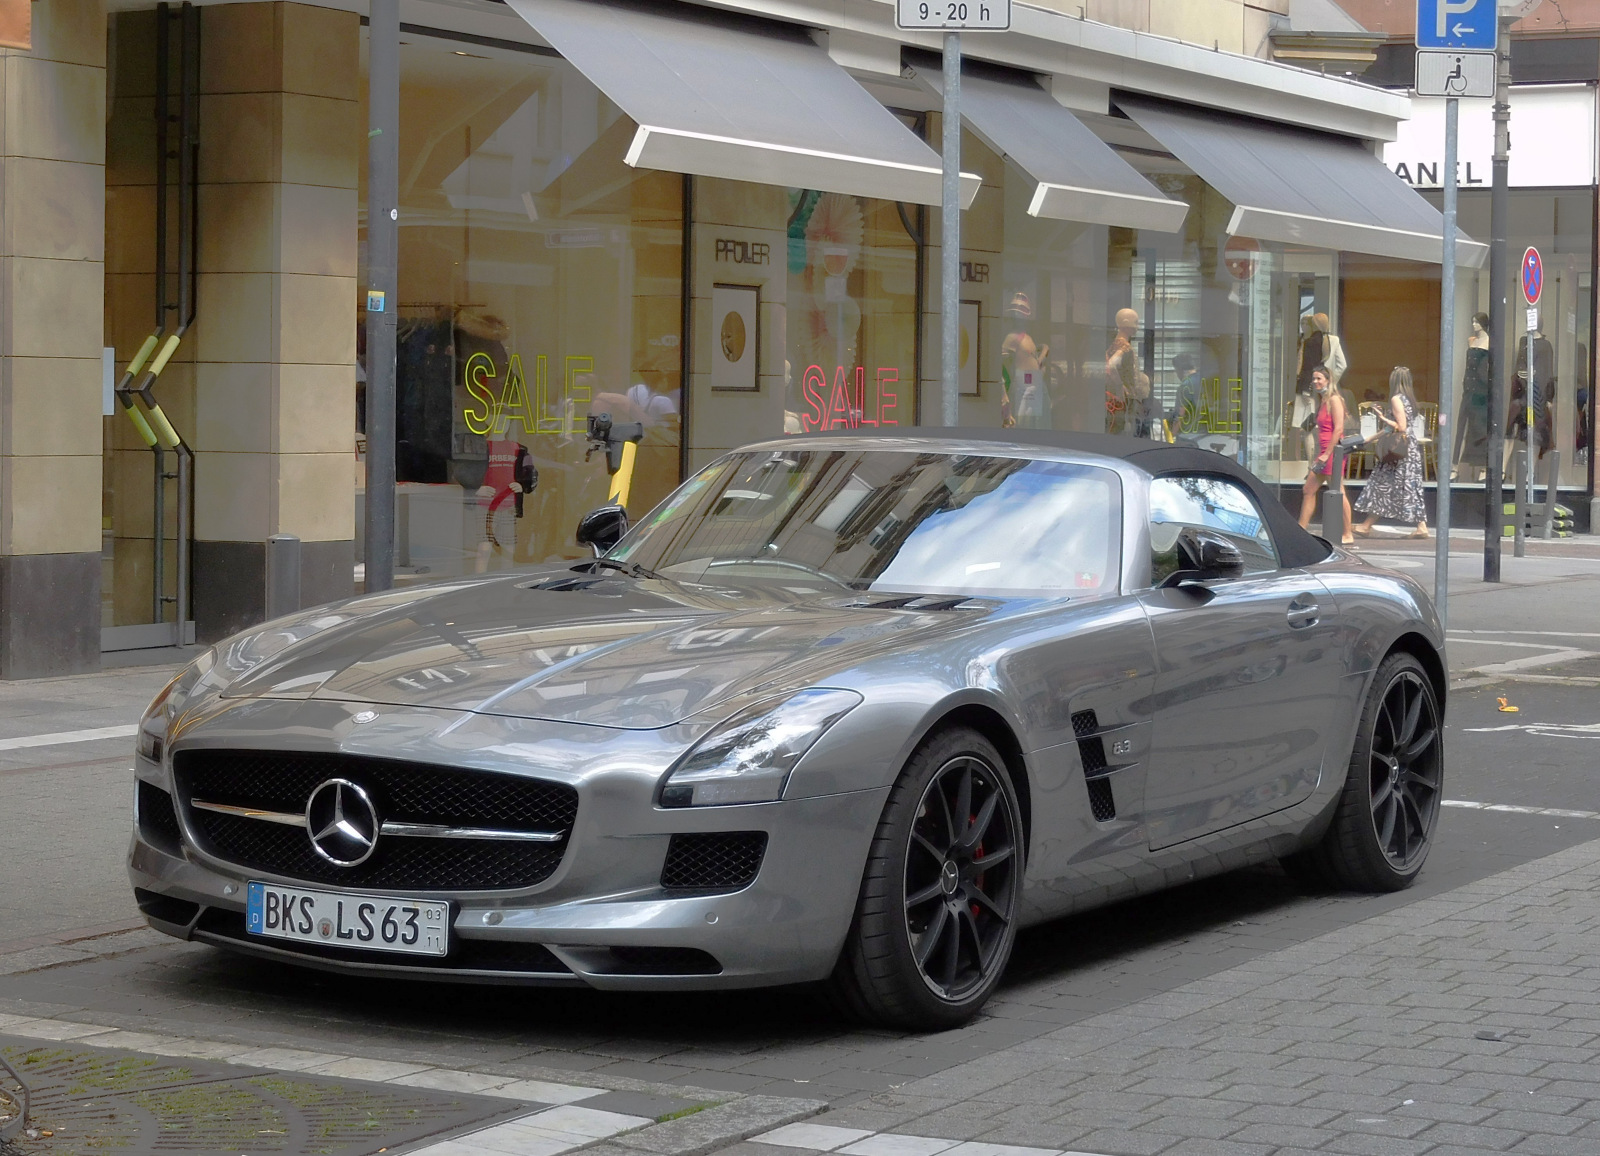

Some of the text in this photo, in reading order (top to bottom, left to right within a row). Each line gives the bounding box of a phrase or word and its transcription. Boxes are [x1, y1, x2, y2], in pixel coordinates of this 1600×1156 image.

[980, 3, 990, 21] h
[1436, 0, 1478, 37] P
[464, 352, 594, 434] SALE
[802, 364, 899, 432] SALE
[1178, 376, 1243, 434] SALE
[252, 913, 259, 924] D
[265, 891, 315, 934] BKS
[426, 909, 441, 920] 03
[427, 936, 440, 947] 11
